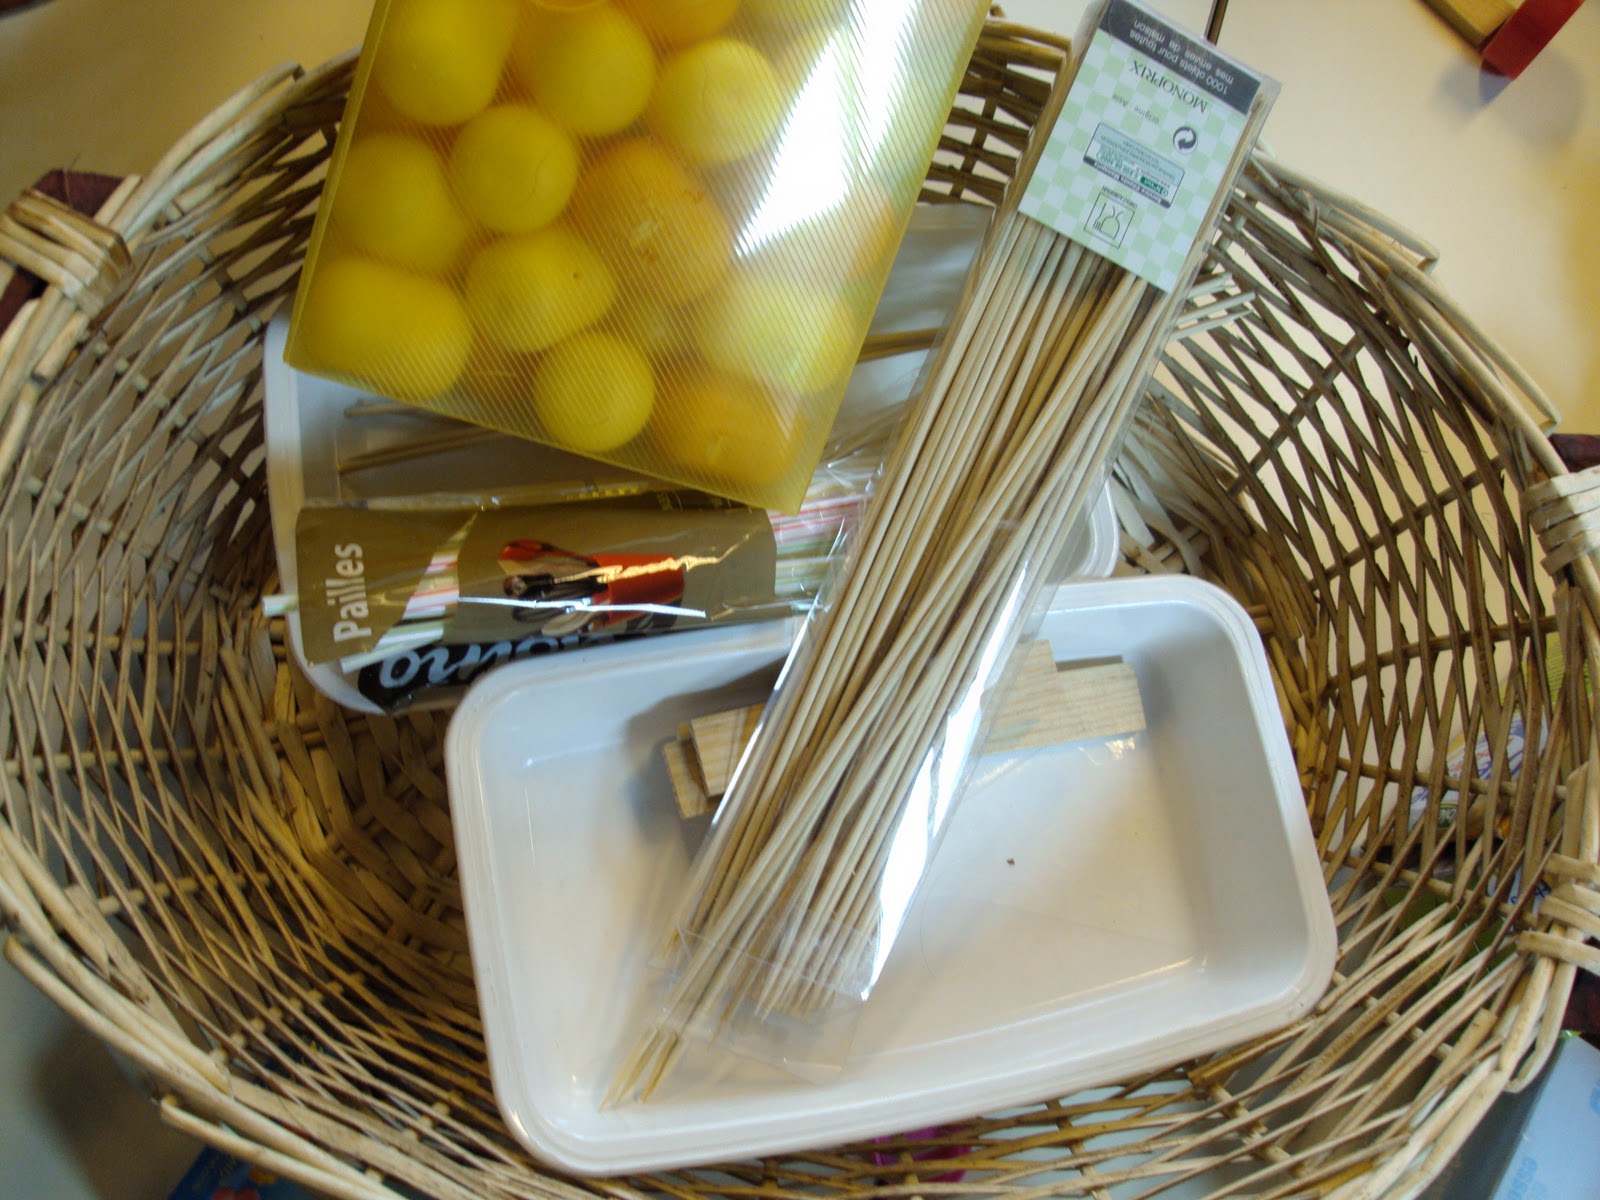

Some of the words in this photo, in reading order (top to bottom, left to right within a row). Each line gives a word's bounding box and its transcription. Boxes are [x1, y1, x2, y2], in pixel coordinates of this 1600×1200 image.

[1130, 29, 1157, 51] toutes
[1134, 19, 1165, 43] maison
[1158, 47, 1178, 63] pour
[1169, 40, 1181, 51] de
[1179, 59, 1206, 81] objets
[1185, 48, 1211, 71] envies
[1130, 60, 1208, 113] MONOPRIX
[1206, 76, 1228, 96] 1000
[1216, 69, 1234, 84] mes
[1112, 93, 1128, 108] Asie
[1134, 106, 1160, 124] origine
[325, 543, 372, 642] Pailles
